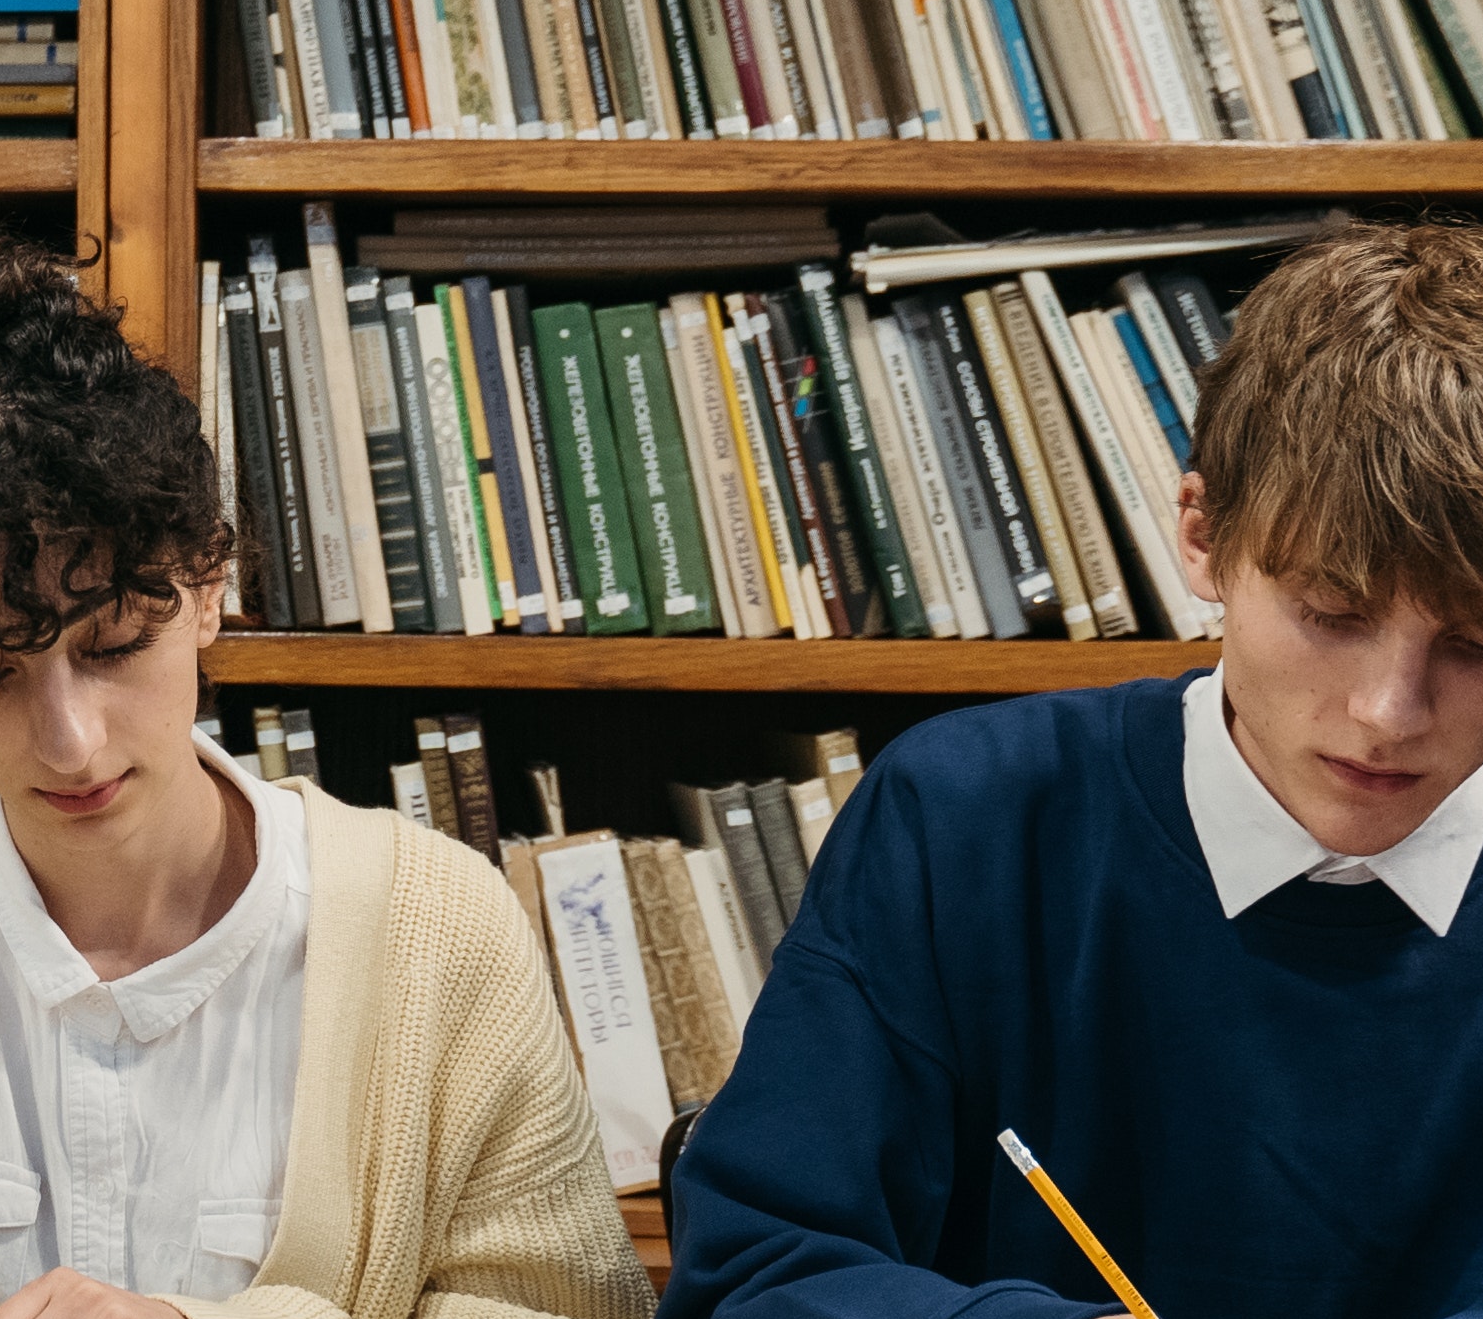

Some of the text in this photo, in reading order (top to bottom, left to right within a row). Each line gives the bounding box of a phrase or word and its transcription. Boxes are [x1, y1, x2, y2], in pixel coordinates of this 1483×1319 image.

[268, 346, 284, 397] РИСУНОК
[813, 285, 853, 381] архитектур
[562, 354, 616, 597] ЖЕЛЕЗОБЕТОННЫЕ КОНСТРУКЦ
[624, 353, 683, 599] ЖЕЛЕЗОБЕТОННЫЕ КОНСТРУКЦ
[690, 333, 762, 608] АРХИТЕКТУРНЫЕ КОНСТРУКЦИИ
[836, 382, 869, 451] История
[559, 887, 610, 1045] ХИТЕКТОРЫ
